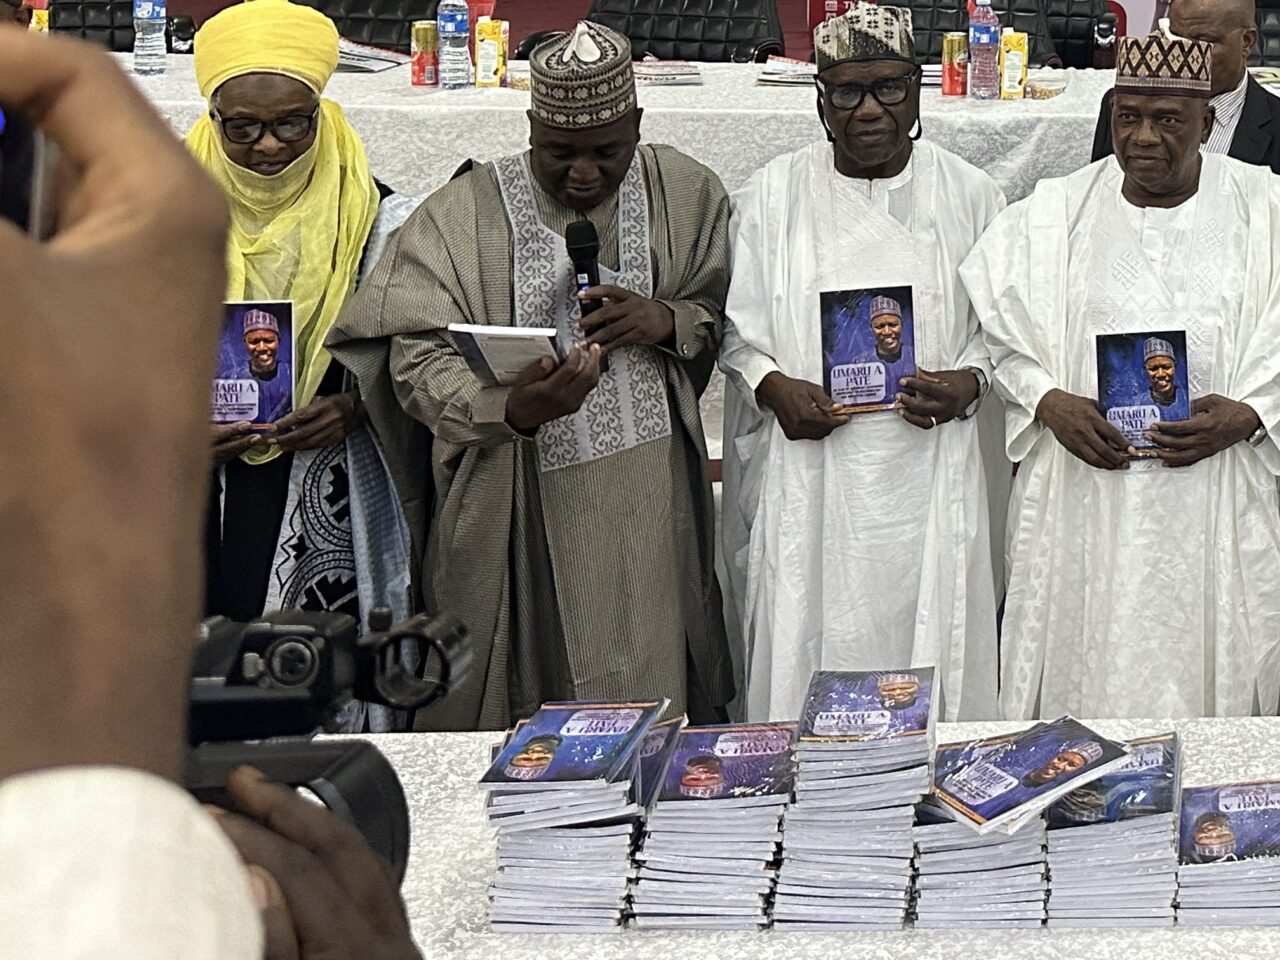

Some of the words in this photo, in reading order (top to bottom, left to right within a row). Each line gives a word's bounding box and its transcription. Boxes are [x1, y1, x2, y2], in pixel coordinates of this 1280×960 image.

[833, 366, 871, 378] UMARU
[874, 366, 883, 375] A
[846, 376, 871, 387] PATE
[1109, 409, 1146, 421] UMARU
[1149, 408, 1158, 418] A
